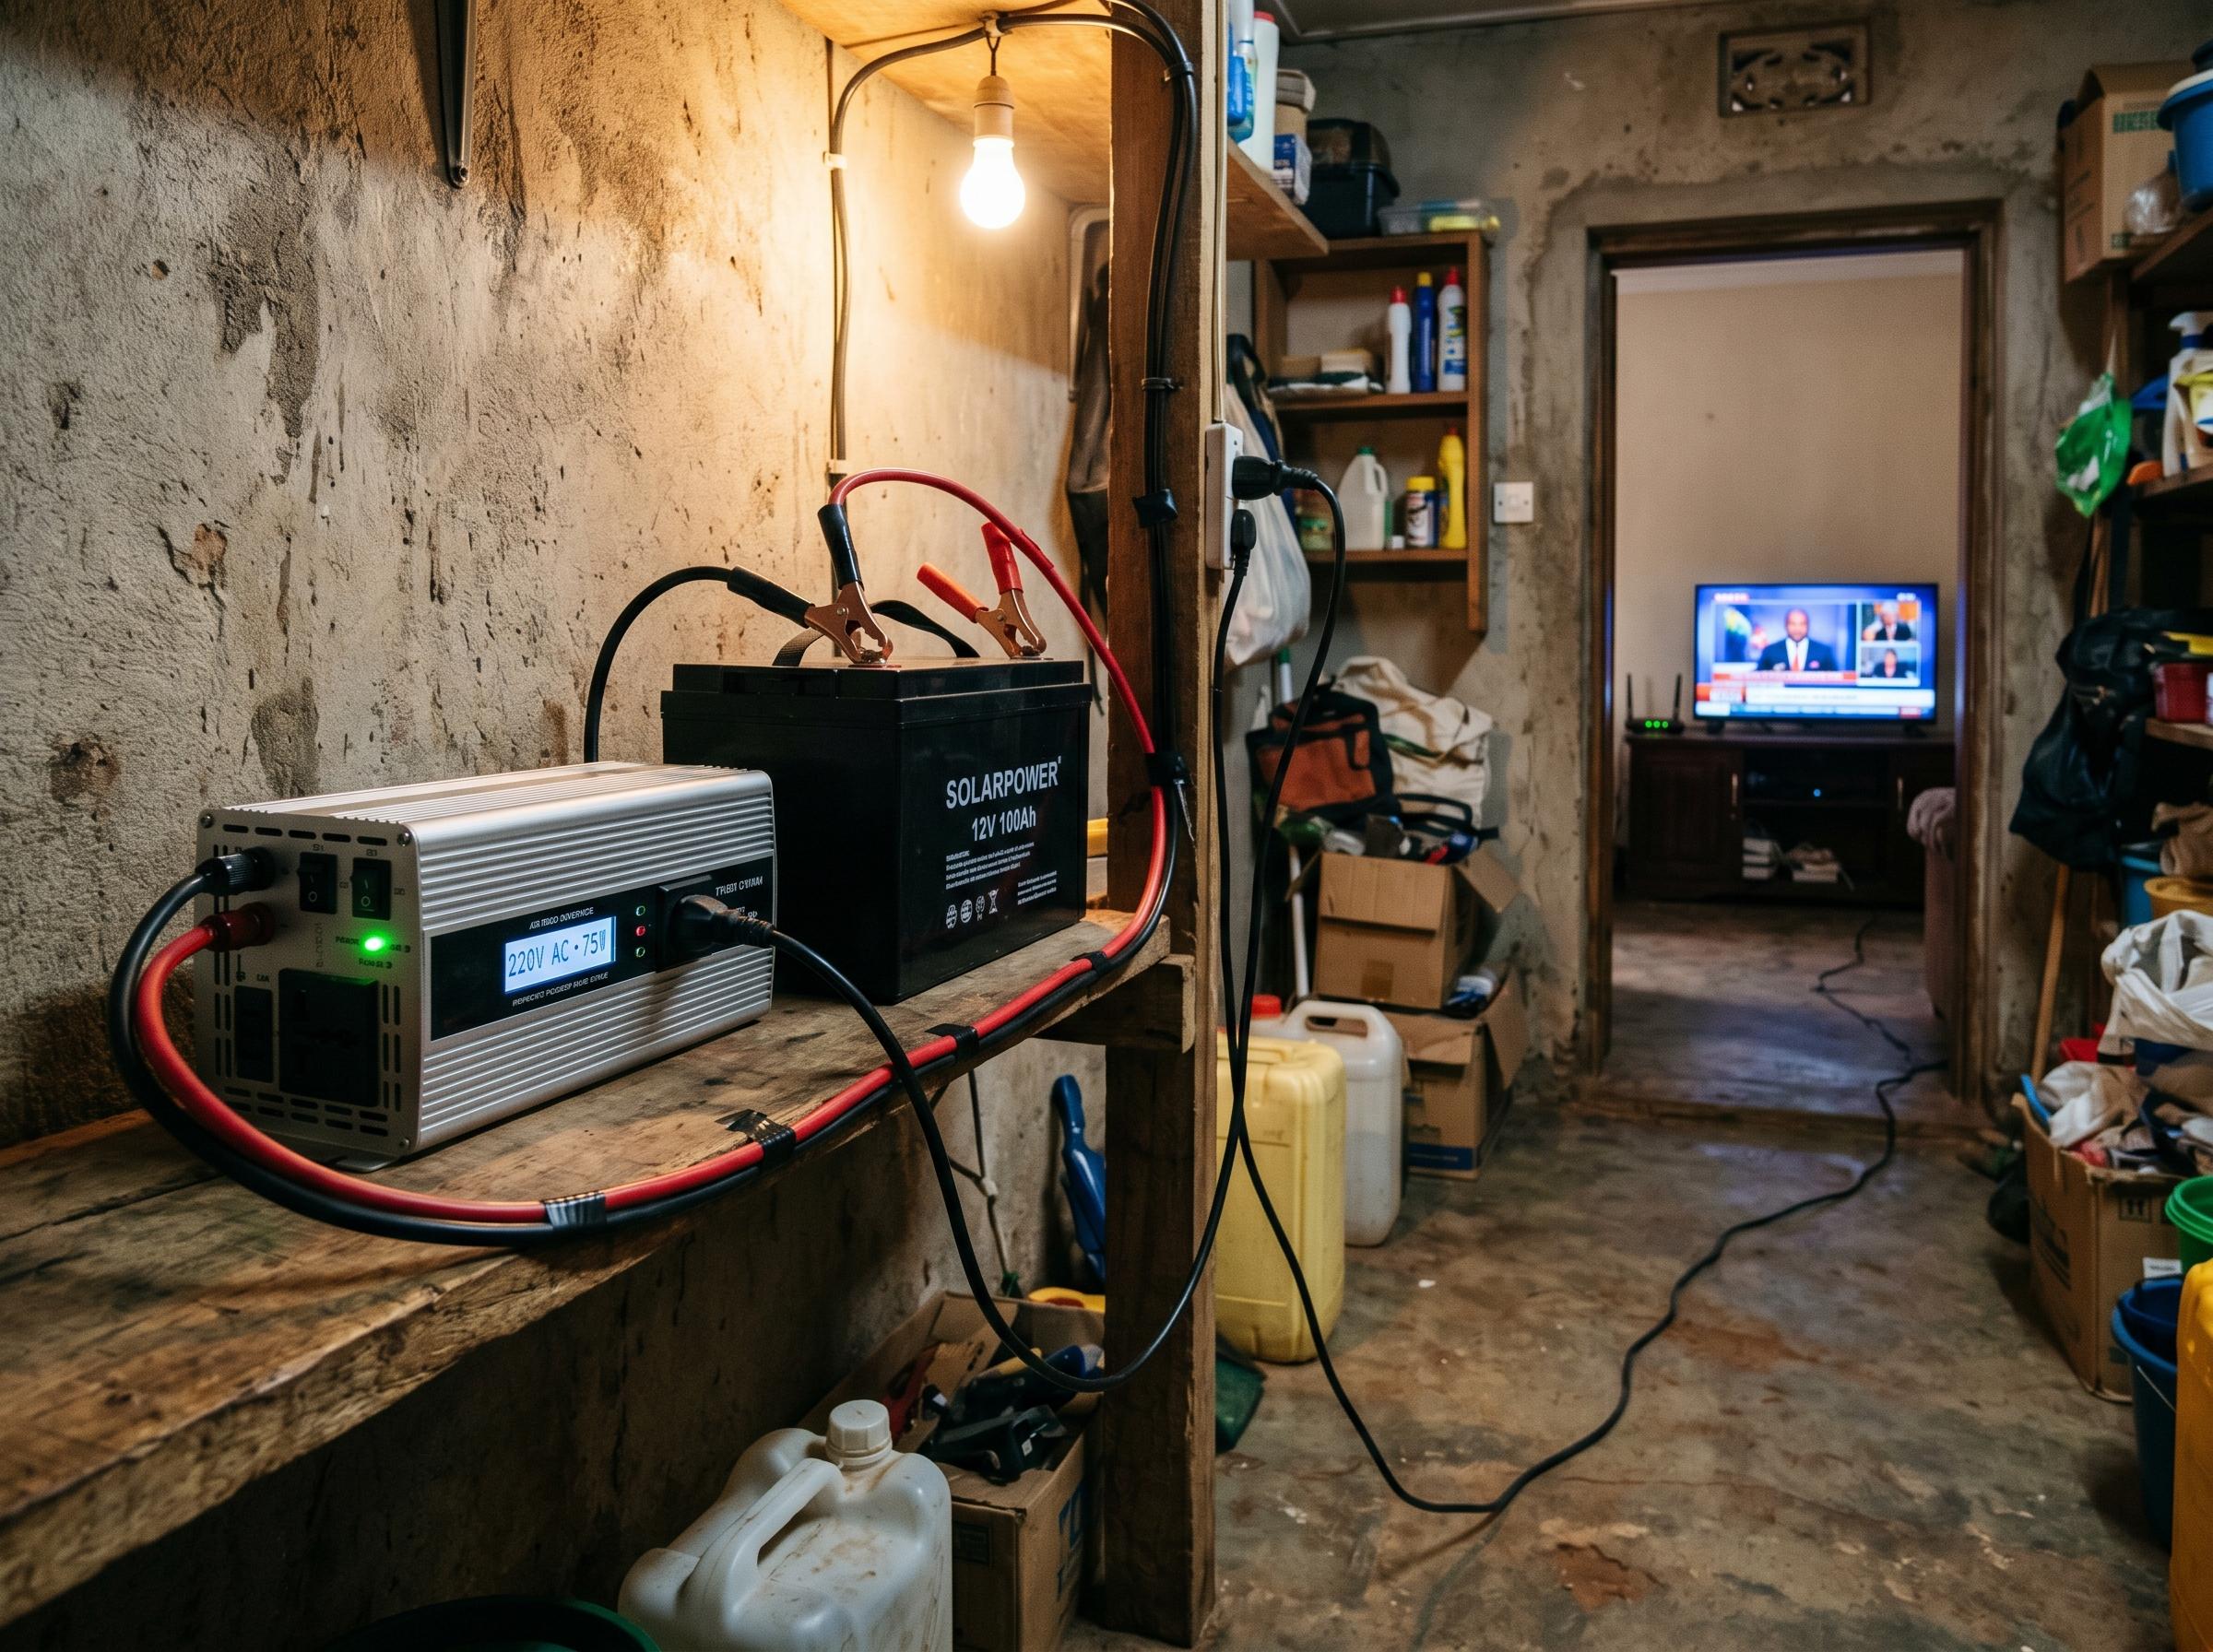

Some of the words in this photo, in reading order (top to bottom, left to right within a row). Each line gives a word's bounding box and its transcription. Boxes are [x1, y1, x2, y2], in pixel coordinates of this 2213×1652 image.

[946, 761, 1059, 809] SOLARPOWER
[972, 814, 997, 842] 12V
[1000, 805, 1036, 835] 100Ah
[508, 945, 544, 977] 220V
[551, 939, 569, 965] AC
